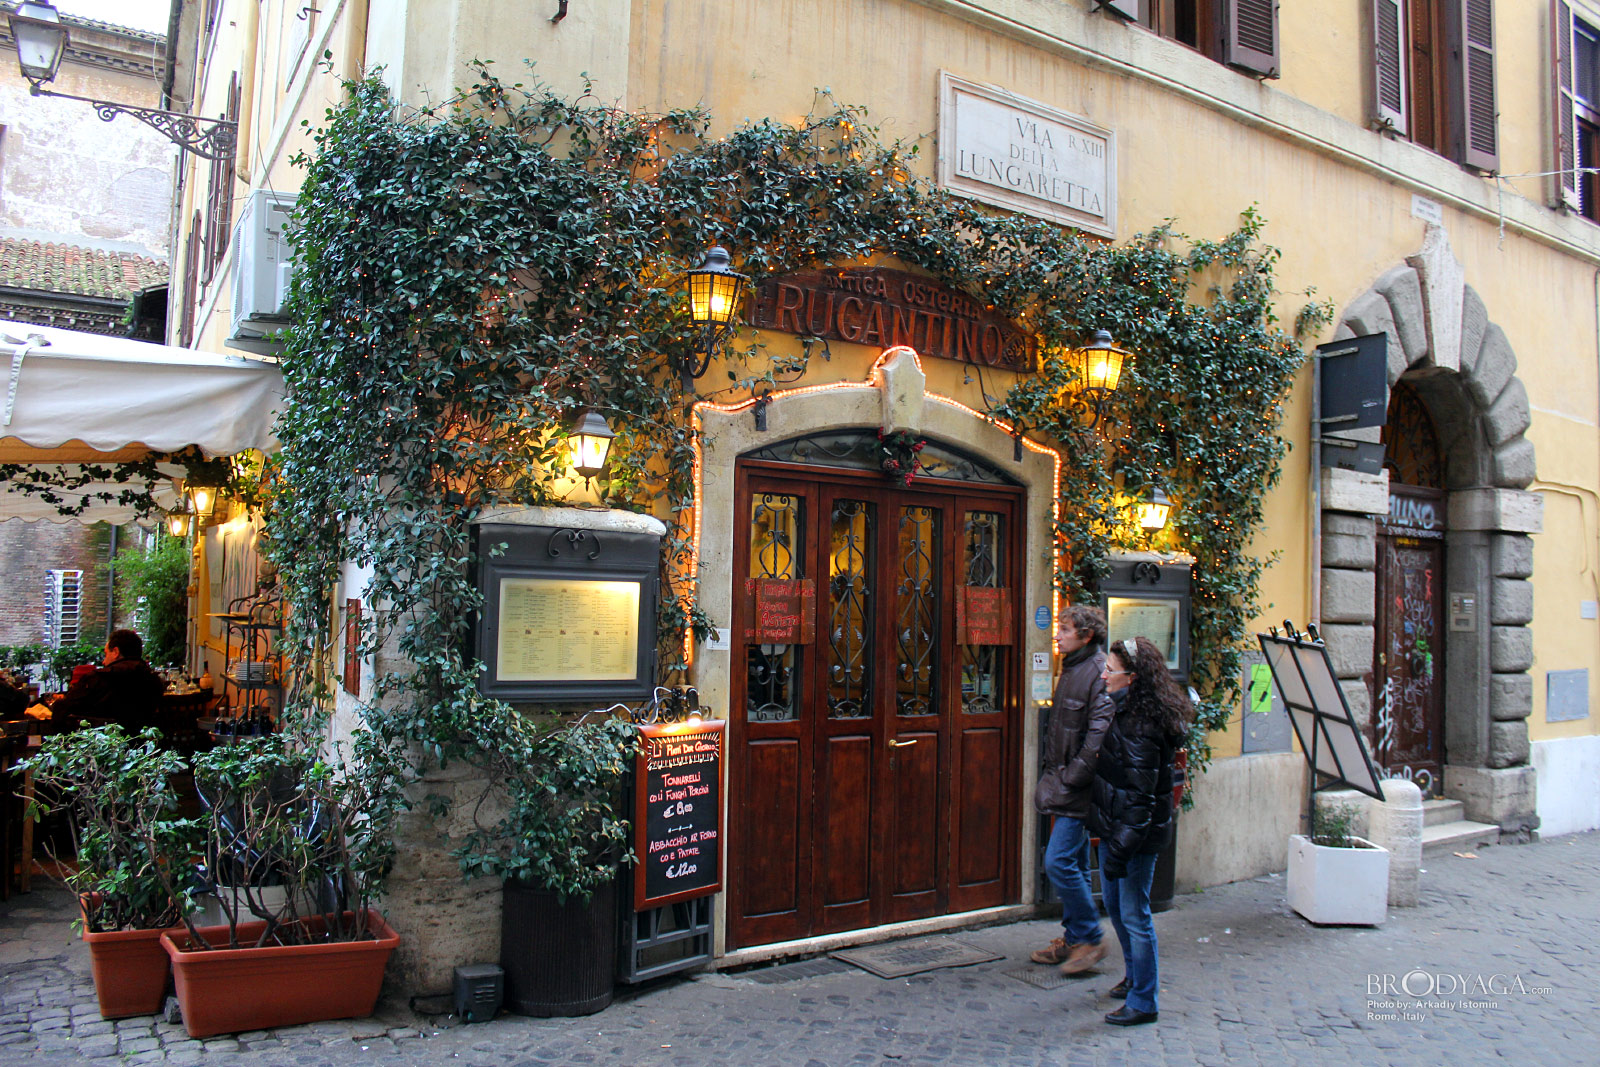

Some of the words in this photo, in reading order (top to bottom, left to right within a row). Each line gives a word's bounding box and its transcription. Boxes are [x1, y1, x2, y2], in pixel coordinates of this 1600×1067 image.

[1016, 117, 1053, 149] VIA
[1010, 143, 1058, 172] DELLA
[959, 150, 1102, 212] LUNGARETTA
[826, 276, 888, 299] ANTICA
[774, 282, 1003, 366] RUGANTINO
[678, 847, 700, 859] PATATE
